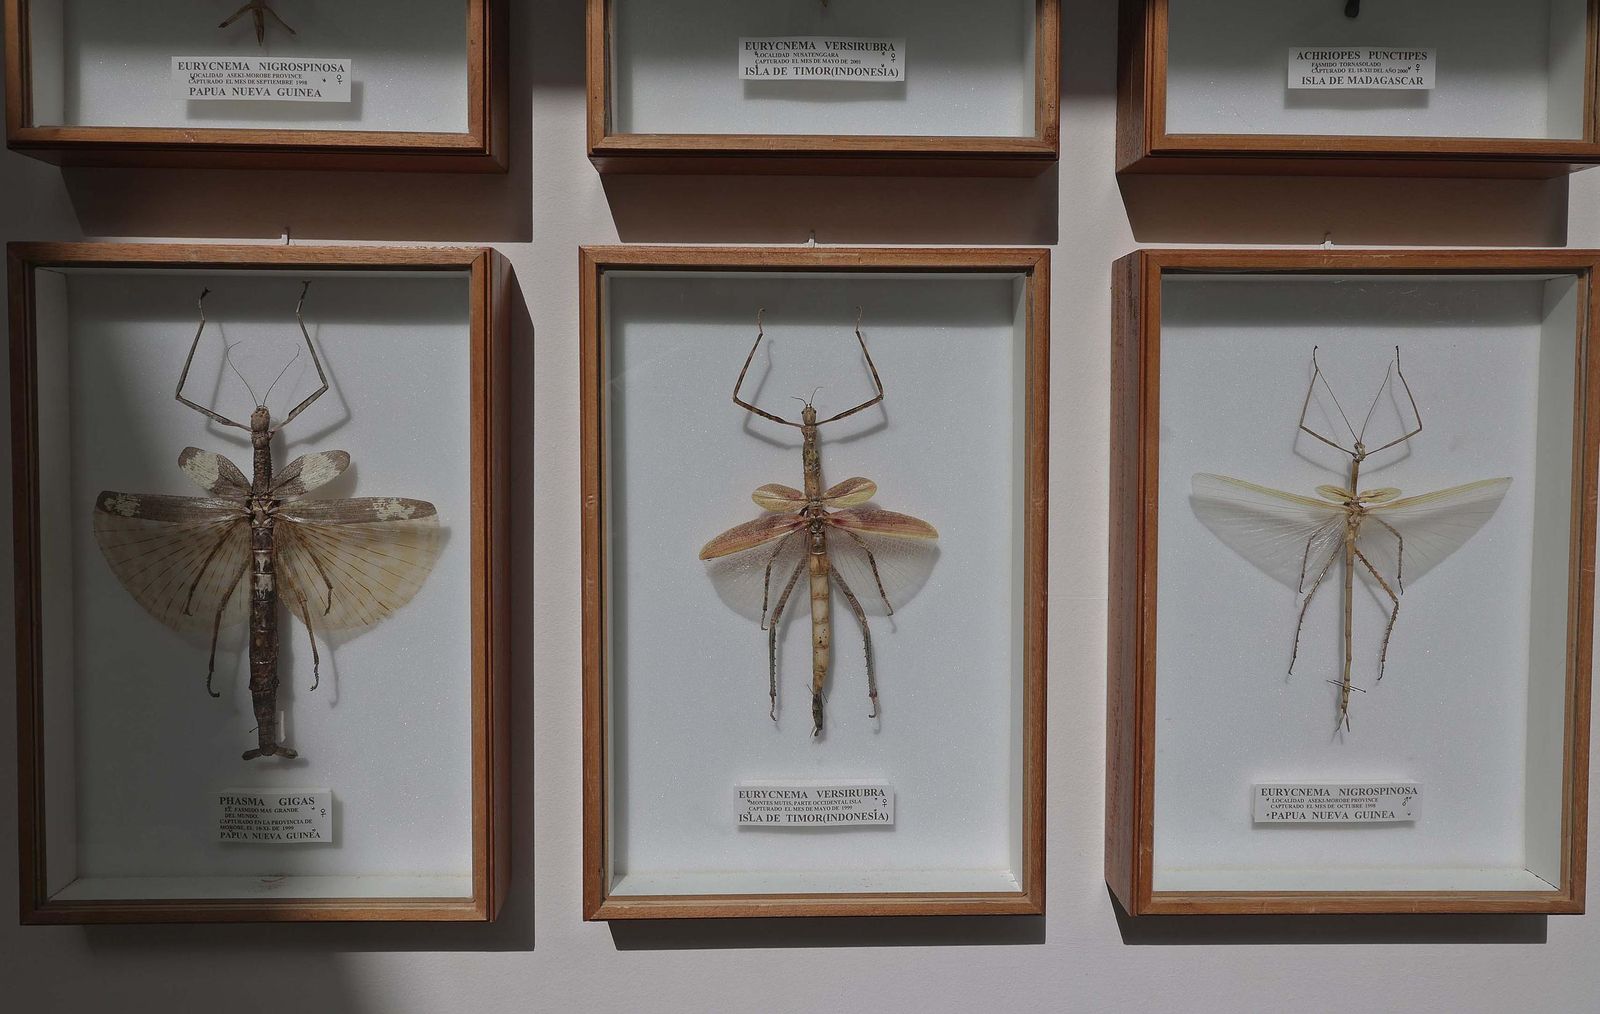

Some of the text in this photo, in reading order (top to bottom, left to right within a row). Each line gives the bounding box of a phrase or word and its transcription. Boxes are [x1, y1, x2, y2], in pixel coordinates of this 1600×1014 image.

[745, 41, 895, 51] EURYCNEMA VERSIRUBRA
[1297, 51, 1427, 60] ACHRIOPES PUNCTIPES
[178, 62, 344, 72] EURYCNEMA NIGROSPINOSA
[745, 67, 770, 75] ISLA
[773, 67, 787, 75] DE
[1348, 76, 1423, 85] MADAGASCAR
[232, 88, 270, 96] NUEVA
[277, 88, 322, 97] GUINEA
[817, 789, 885, 798] VERSIRUBRA
[1261, 787, 1418, 796] EURYCNEMA NIGROSPINOSA
[220, 797, 315, 806] PHASMA GIGAS
[739, 814, 763, 822] ISLA
[766, 814, 781, 822] DE
[1355, 811, 1395, 819] GUINEA
